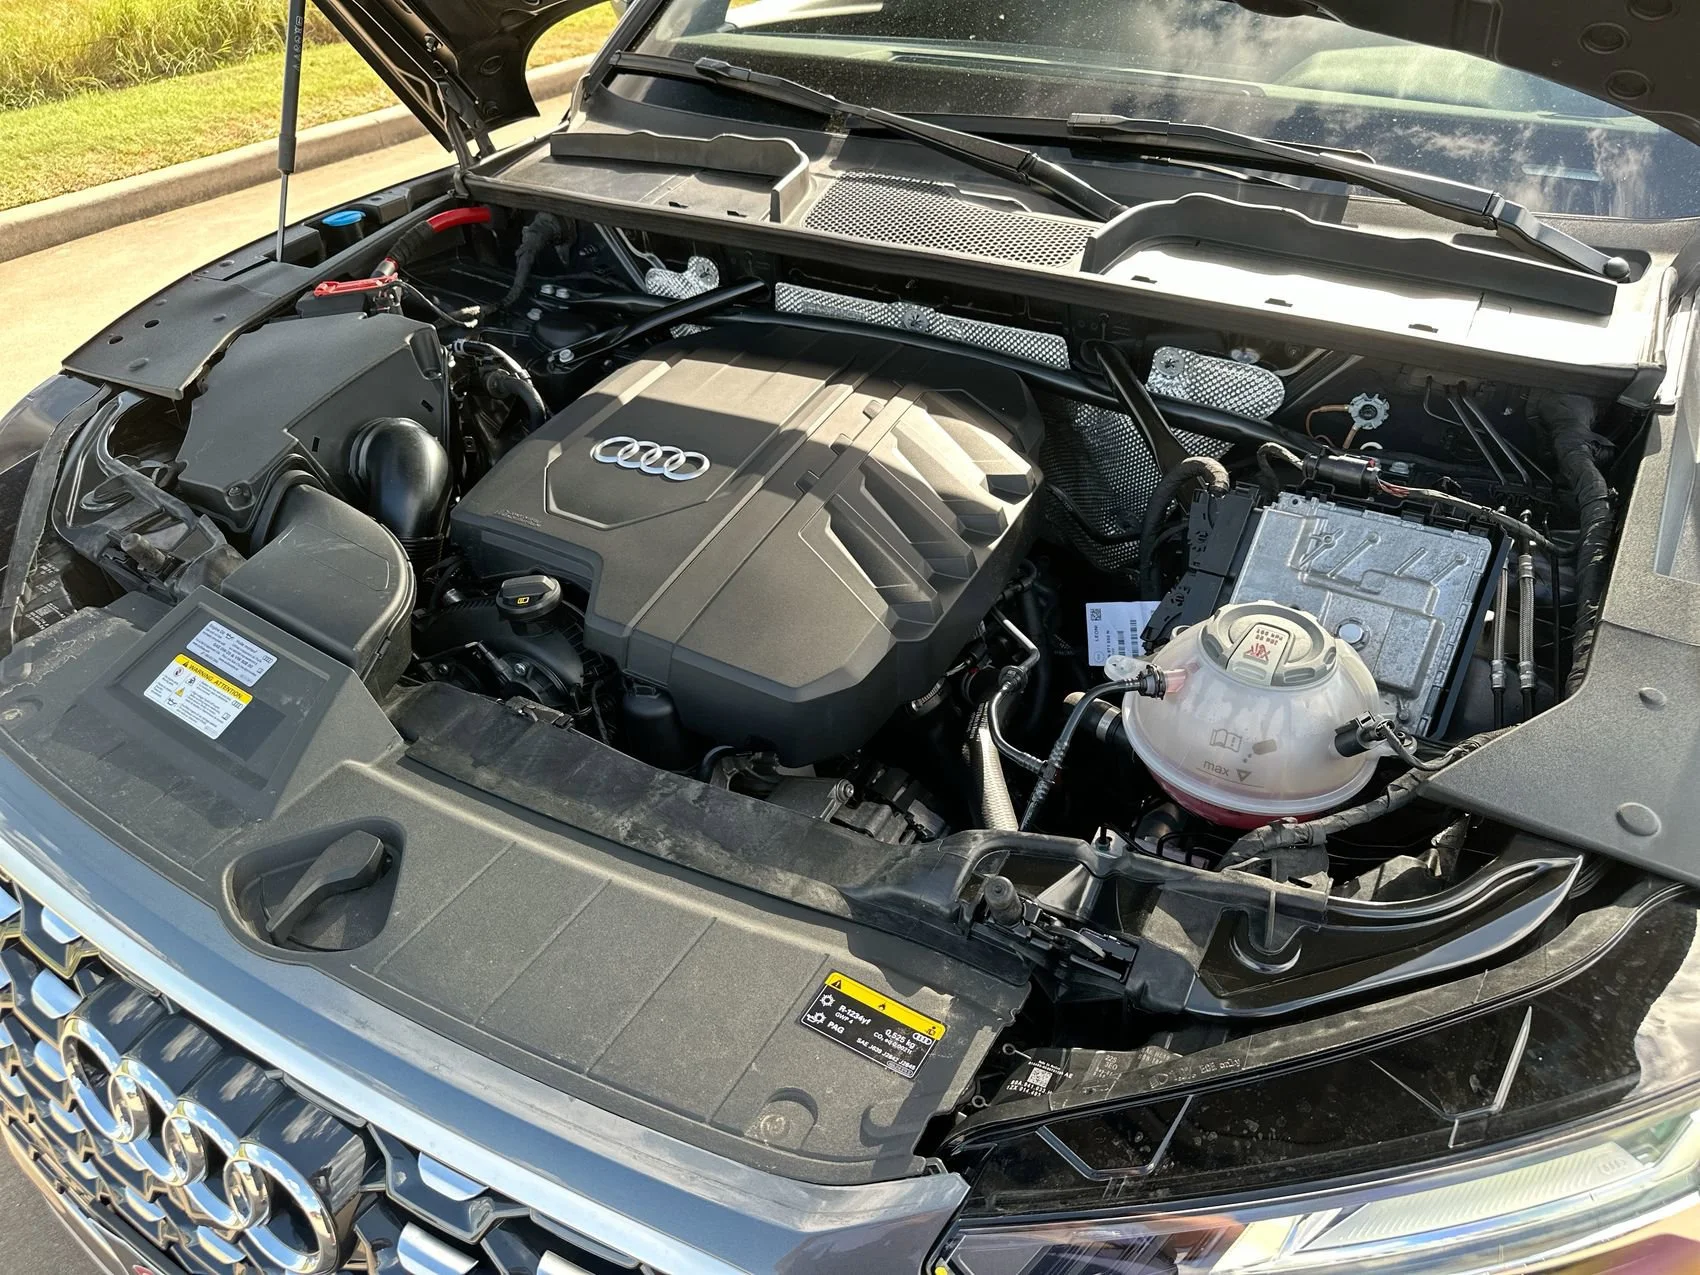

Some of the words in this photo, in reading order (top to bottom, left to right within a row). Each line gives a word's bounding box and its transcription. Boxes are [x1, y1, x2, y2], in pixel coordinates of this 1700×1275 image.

[189, 662, 214, 681] WARNING
[214, 679, 243, 699] ATTENTION
[1203, 760, 1230, 777] max
[834, 1012, 850, 1022] GWP
[838, 1004, 872, 1026] R-1234yf
[827, 1021, 845, 1034] PAG
[856, 1037, 869, 1048] SAE
[868, 1043, 883, 1054] J639
[885, 1028, 906, 1044] 0,525
[905, 1039, 917, 1050] kg
[1220, 1058, 1240, 1069] only
